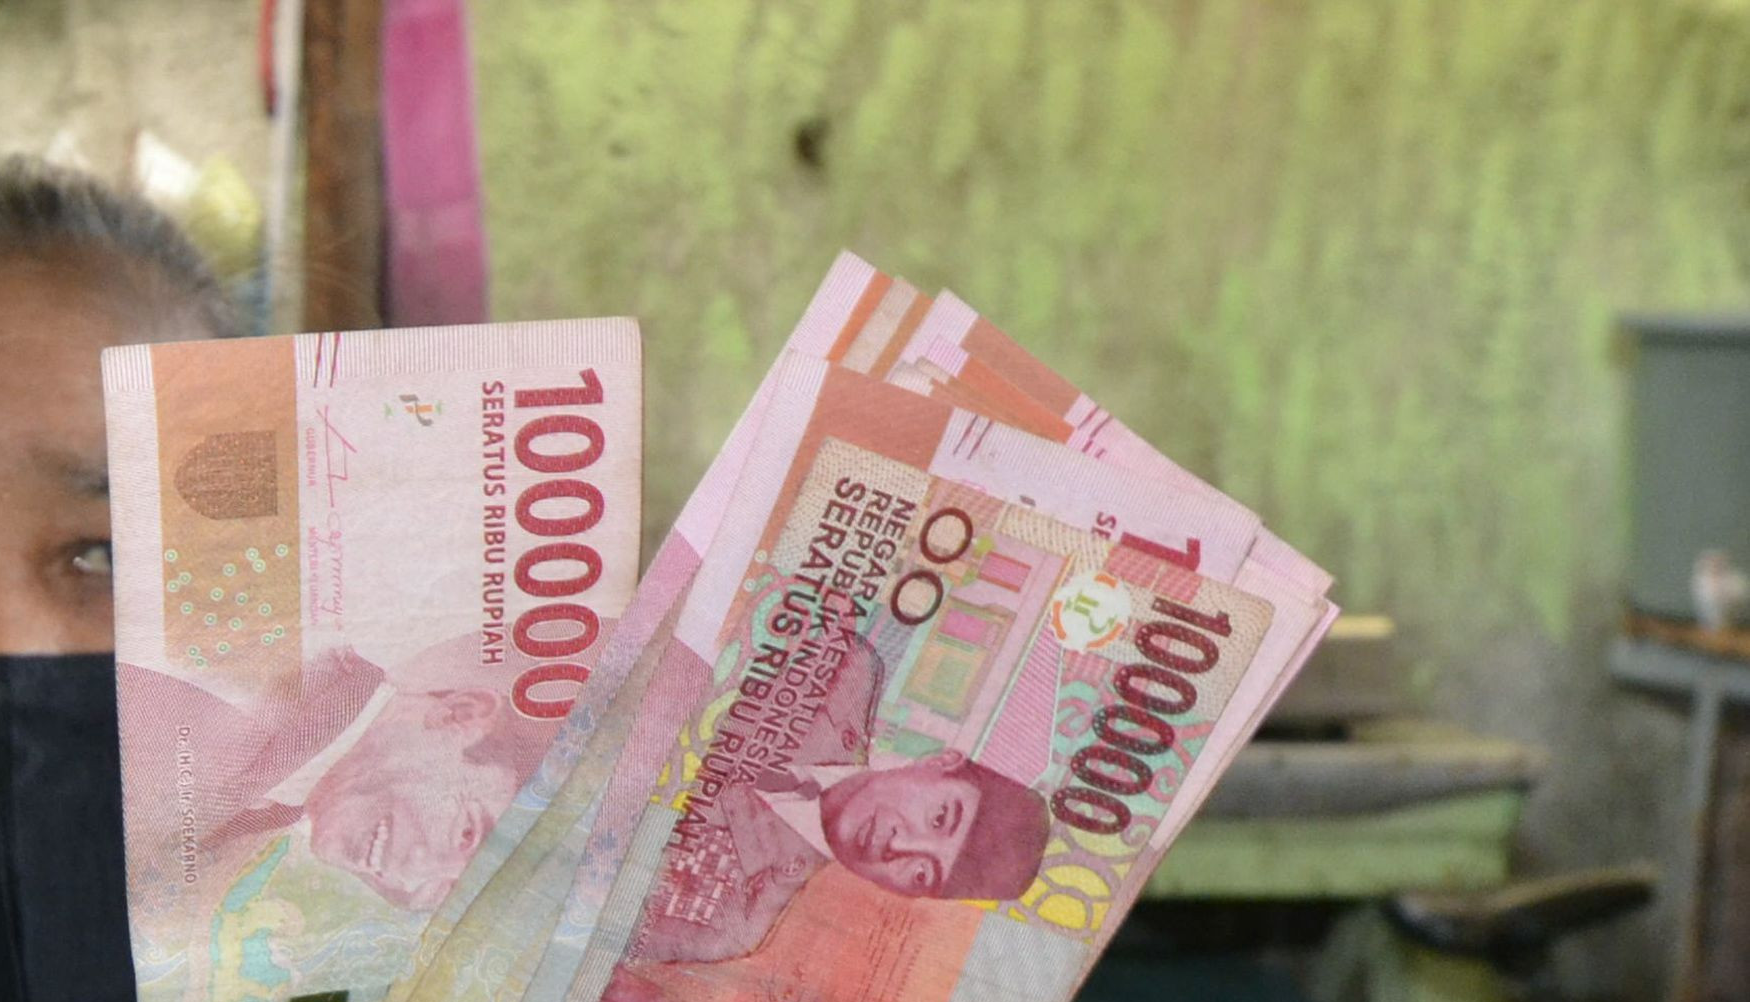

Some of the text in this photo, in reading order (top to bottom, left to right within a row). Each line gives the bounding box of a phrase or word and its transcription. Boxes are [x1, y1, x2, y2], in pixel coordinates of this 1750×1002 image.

[482, 380, 506, 665] SERATUS RIBU RUPIAH
[512, 368, 605, 719] 100000
[666, 474, 867, 855] SERATUS RIBU RUPIAH
[730, 488, 892, 790] REPUBLIK INDONESIA
[767, 496, 916, 773] NEGARA KESATUAN
[182, 809, 197, 884] SOEKARNO
[1050, 597, 1232, 836] 100000
